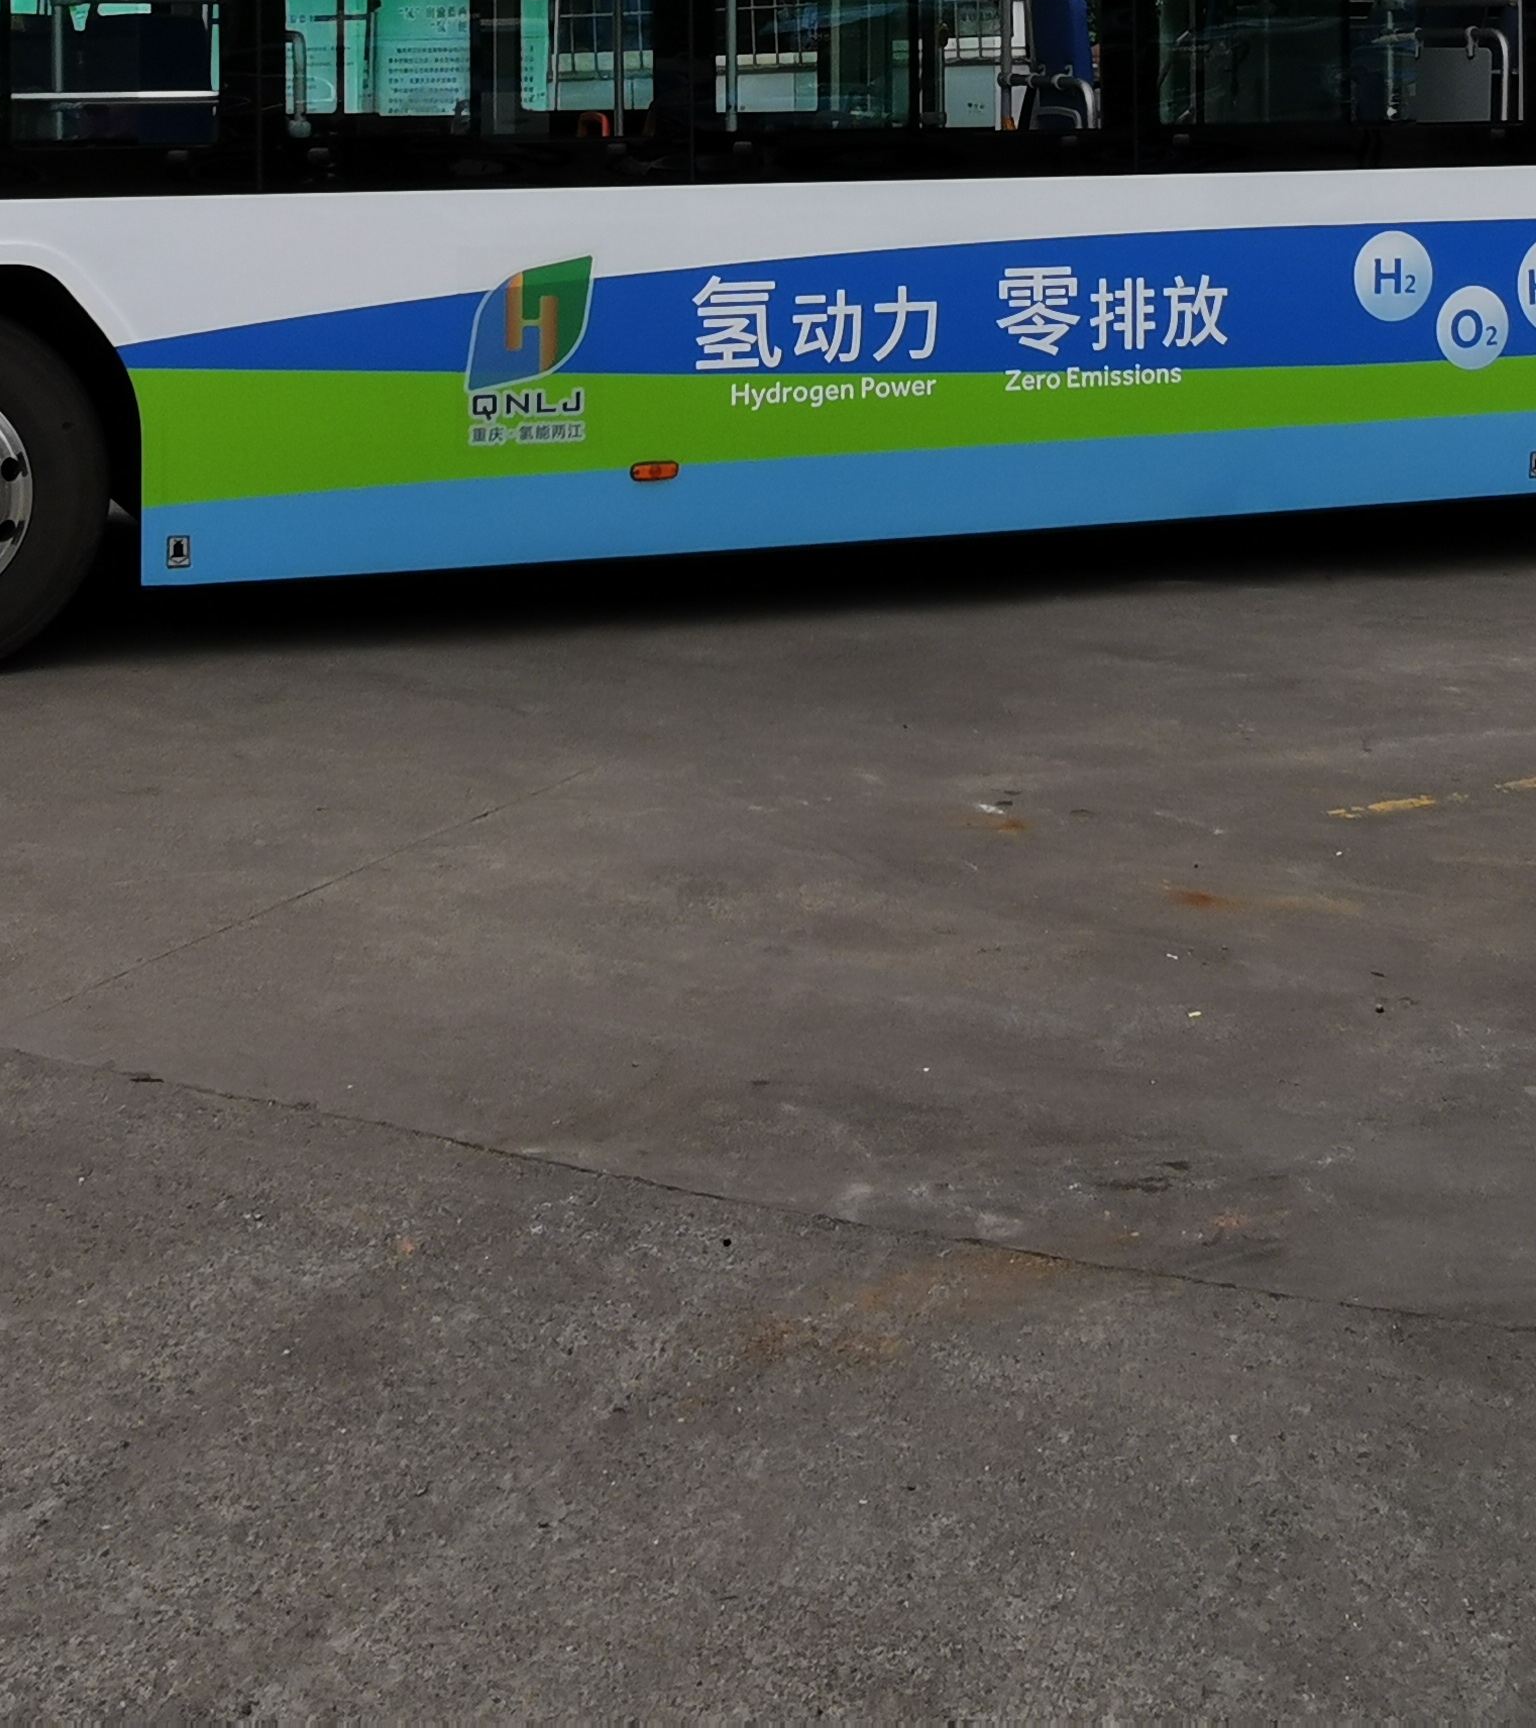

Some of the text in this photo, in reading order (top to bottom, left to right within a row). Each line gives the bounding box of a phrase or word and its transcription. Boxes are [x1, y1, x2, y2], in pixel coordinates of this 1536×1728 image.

[691, 265, 1230, 372] 氢动力 零排放
[472, 391, 582, 420] QNLJ
[730, 360, 1183, 408] Hydrogen Power Zero Emissions
